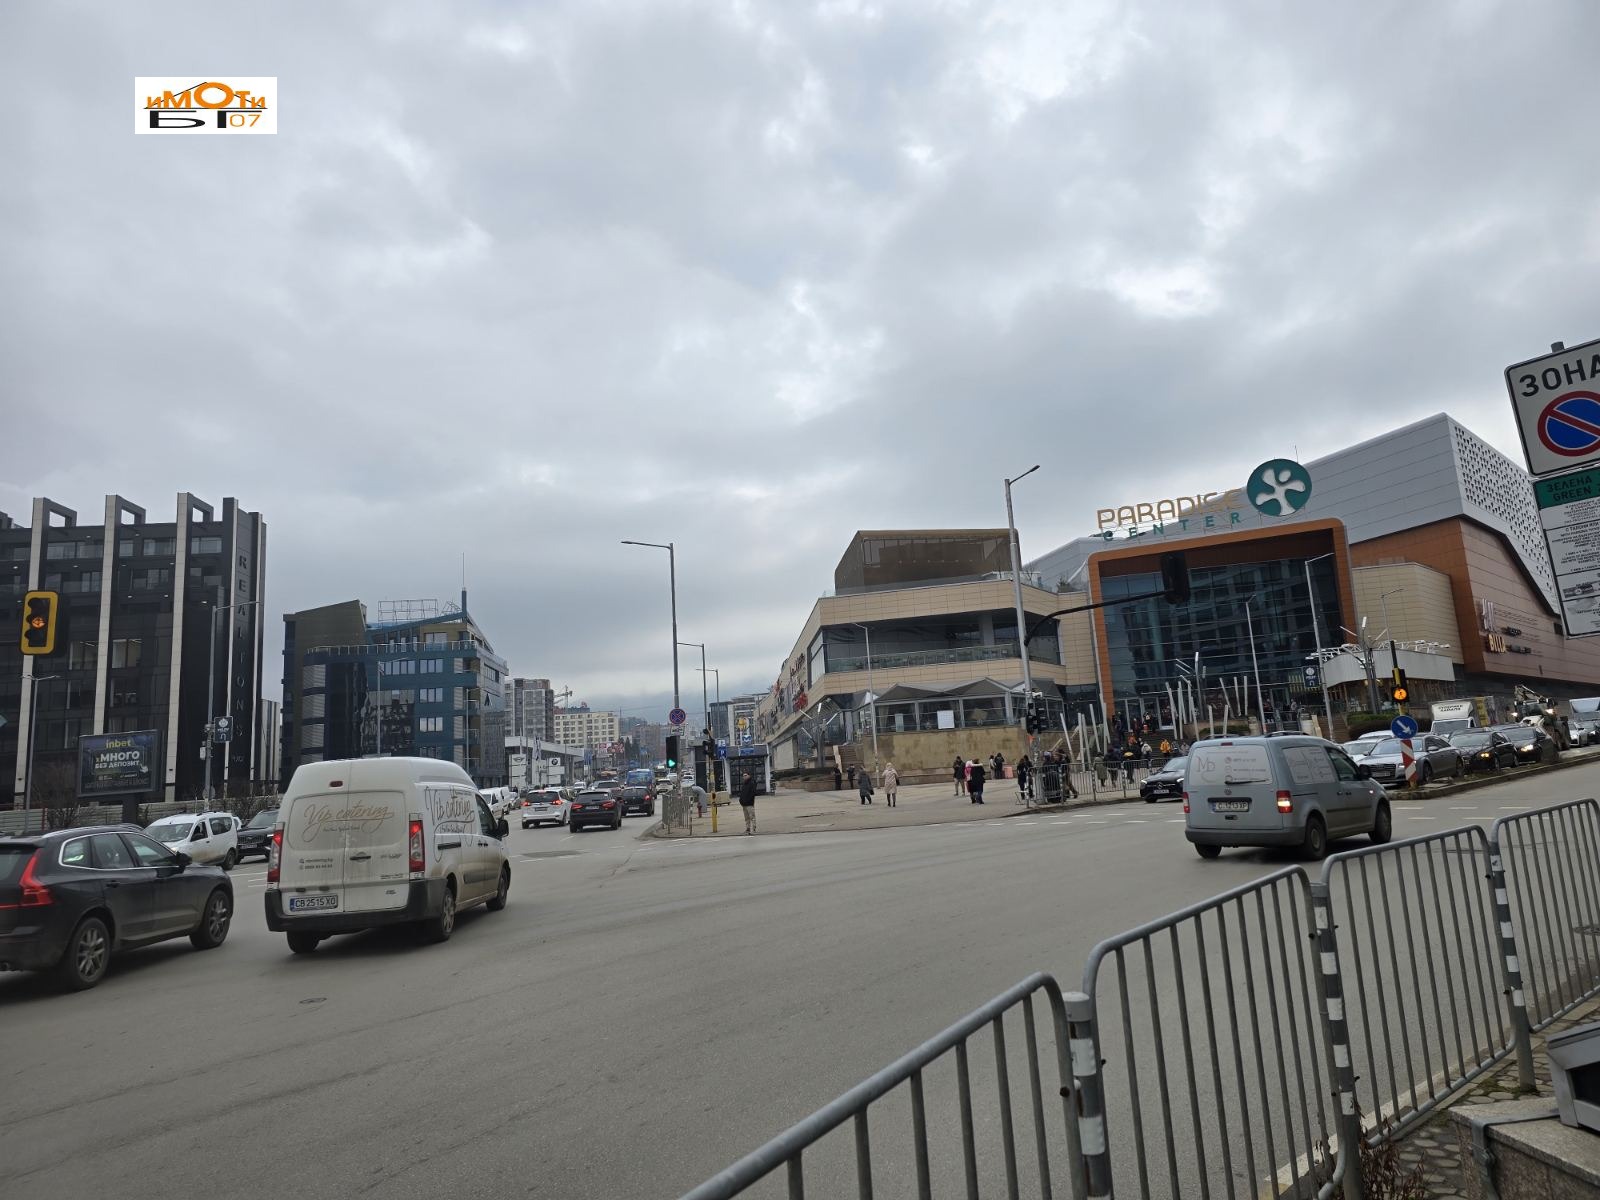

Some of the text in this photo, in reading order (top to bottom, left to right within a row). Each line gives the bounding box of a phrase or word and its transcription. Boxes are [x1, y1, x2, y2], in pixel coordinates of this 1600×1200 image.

[1553, 486, 1592, 501] GREEN
[1097, 488, 1243, 529] PARADISE
[1103, 512, 1241, 542] CENTER
[100, 751, 140, 762] МНОГО
[109, 760, 140, 769] ДЕПОЗИТ
